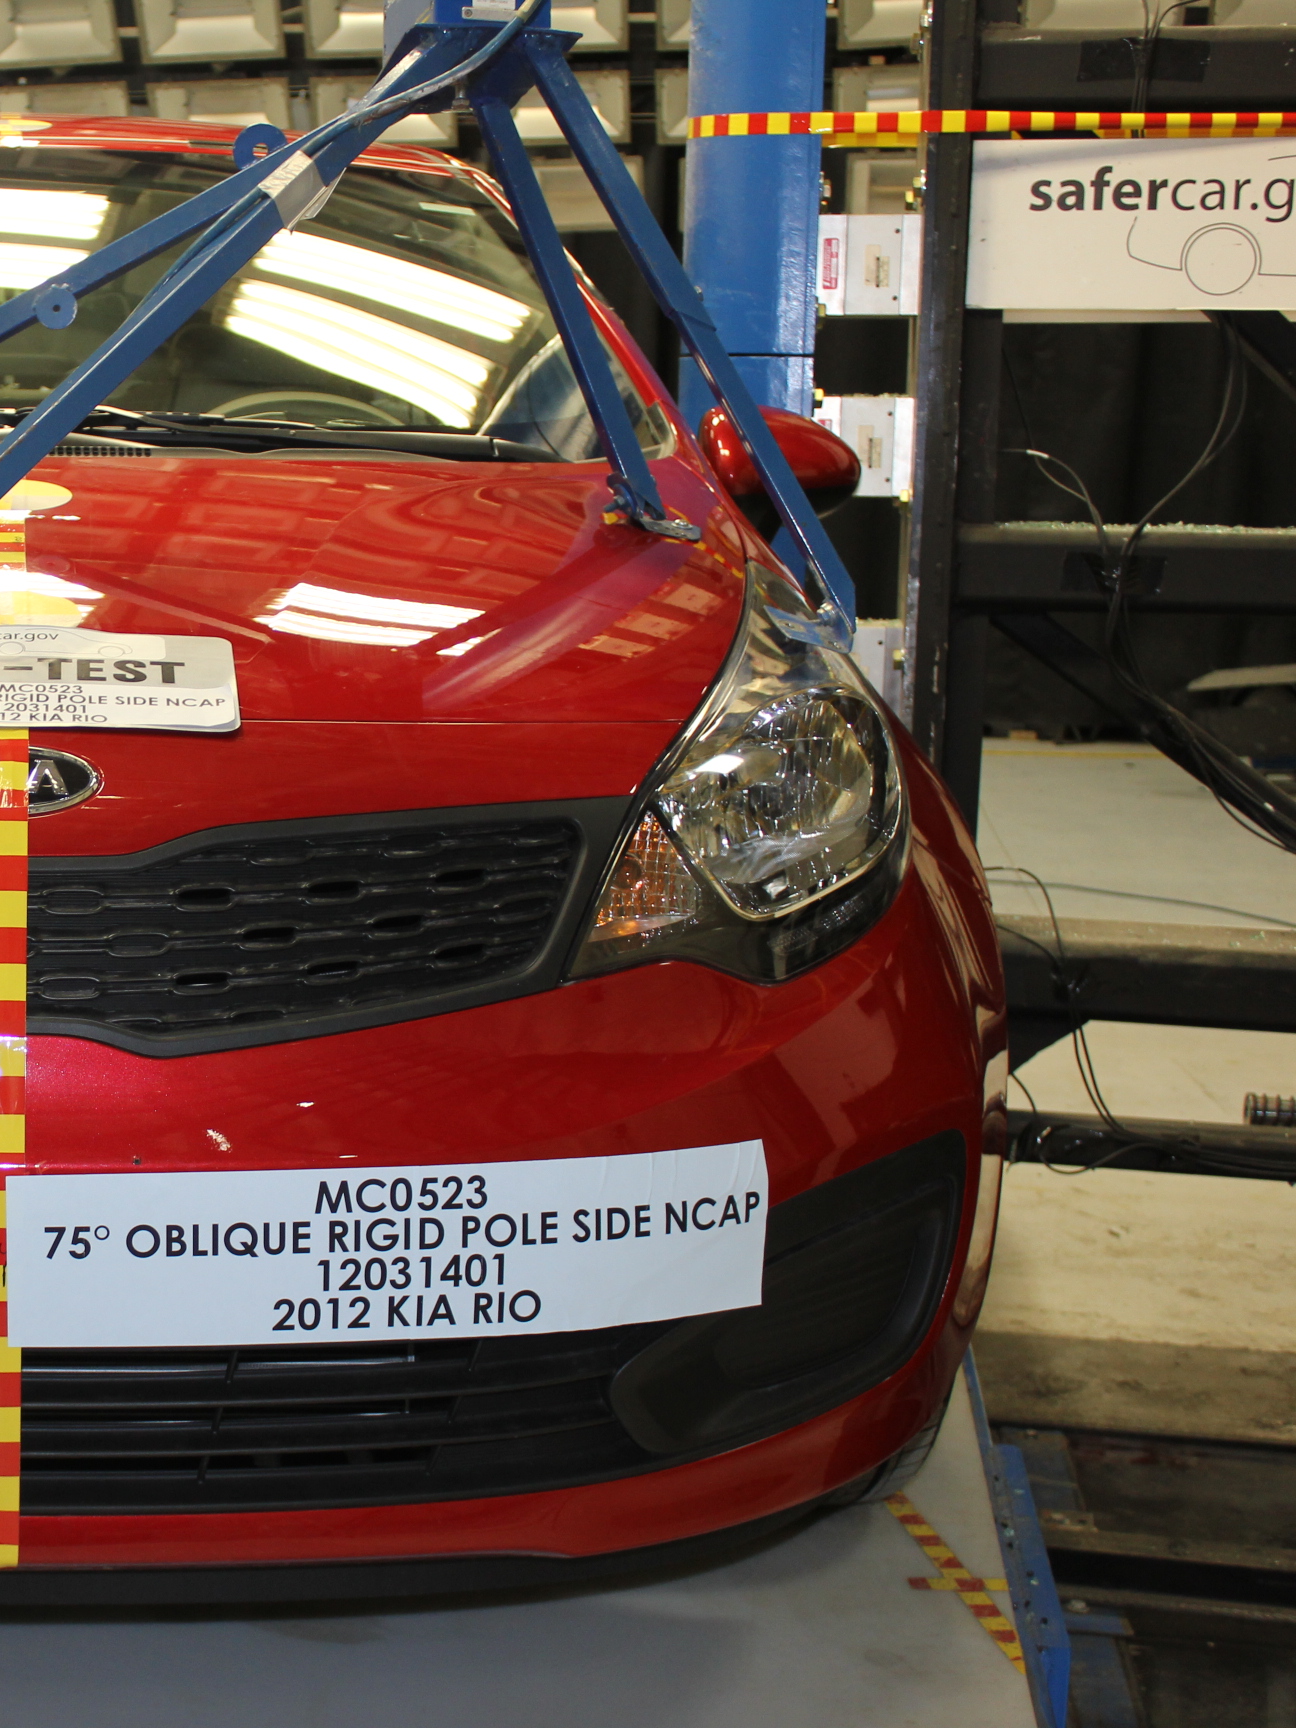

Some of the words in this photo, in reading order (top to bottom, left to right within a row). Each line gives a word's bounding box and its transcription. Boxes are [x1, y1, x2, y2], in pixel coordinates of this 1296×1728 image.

[29, 713, 63, 722] KIA
[72, 714, 108, 723] RIO
[58, 694, 108, 704] POLE
[115, 696, 158, 706] SIDE
[166, 698, 226, 707] NCAP
[314, 1175, 488, 1214] MC0523
[44, 1225, 110, 1260] 75°
[125, 1221, 311, 1258] OBLIQUE
[328, 1217, 445, 1253] RIGID
[461, 1211, 558, 1249] POLE
[572, 1204, 651, 1243] SIDE
[665, 1191, 761, 1235] NCAP
[317, 1253, 505, 1292] 12031401
[271, 1296, 371, 1331] 2012
[387, 1294, 457, 1328] KIA
[473, 1290, 541, 1325] RIO
